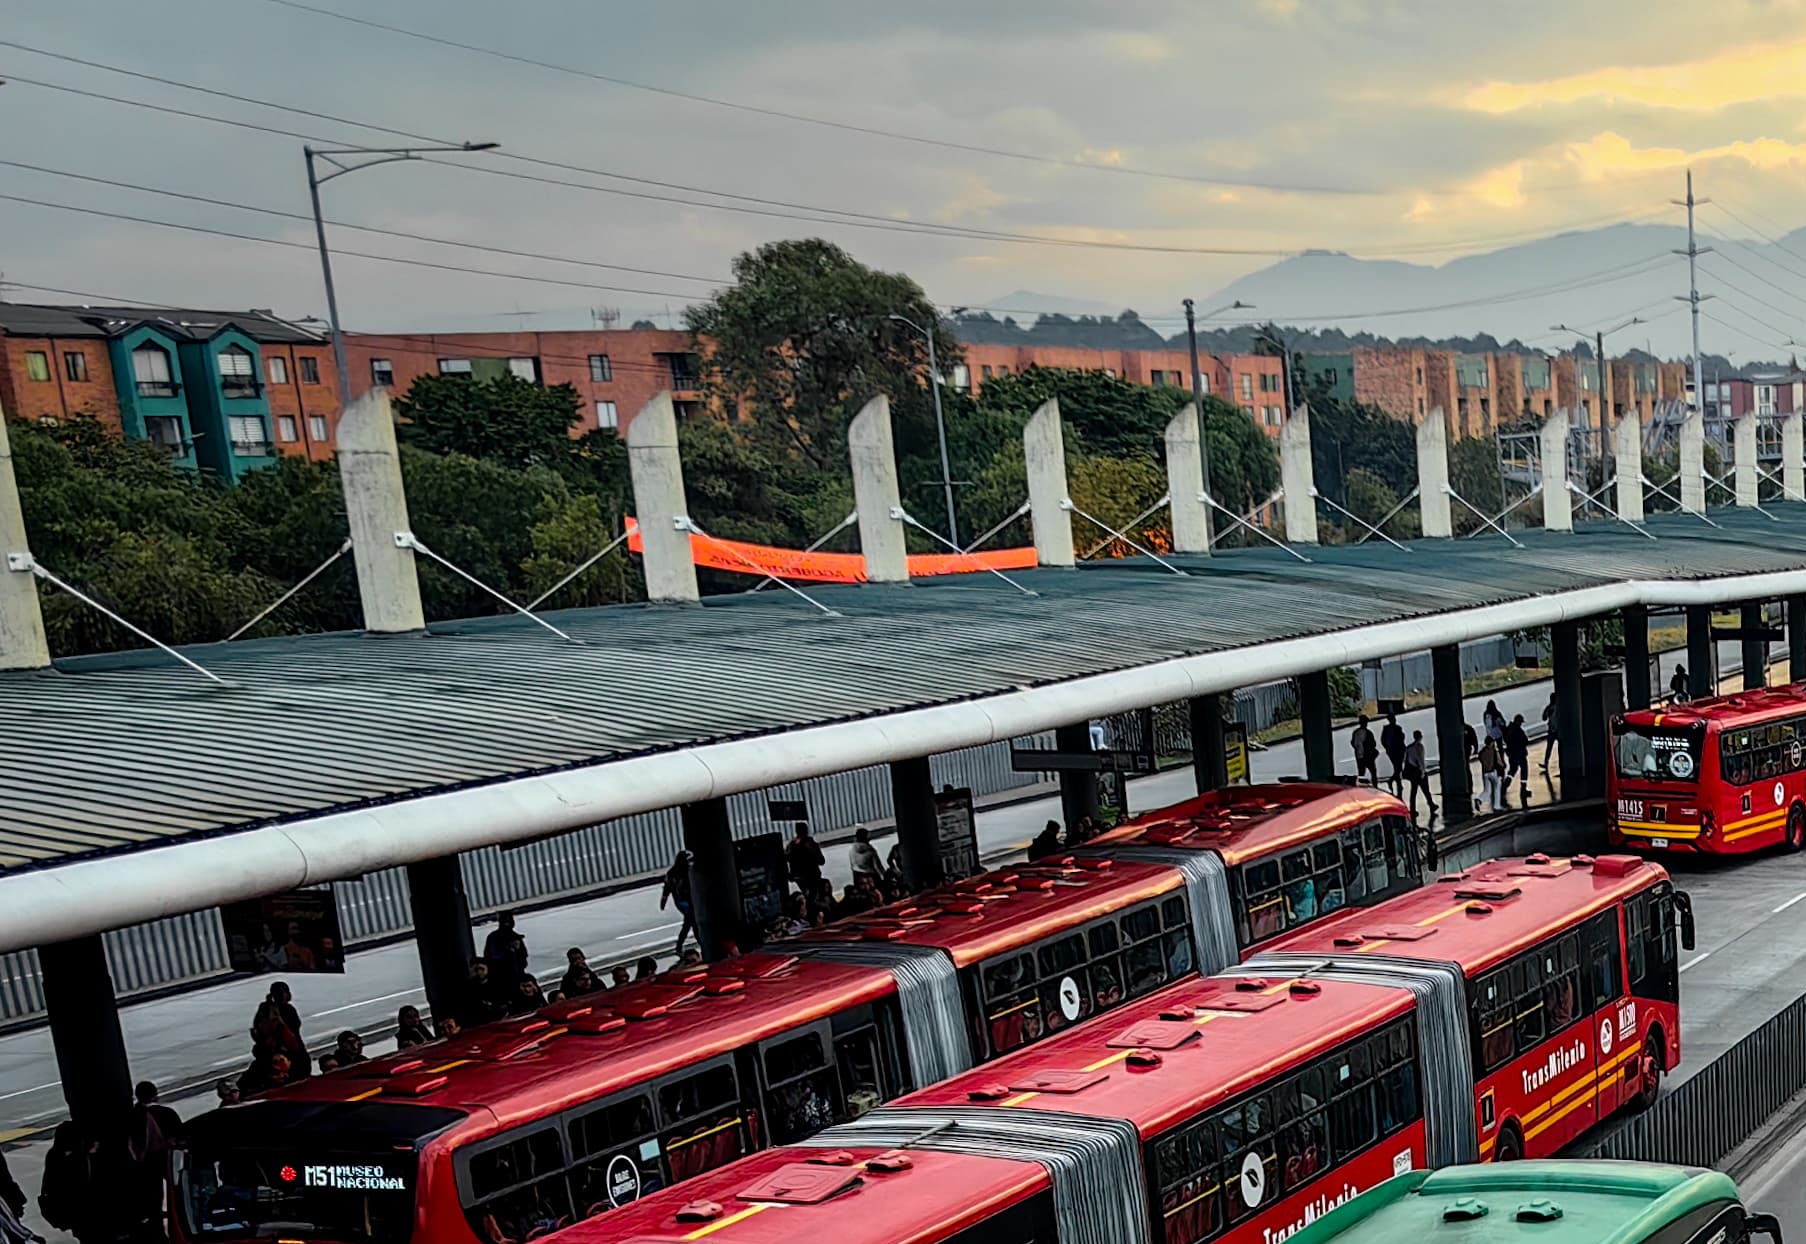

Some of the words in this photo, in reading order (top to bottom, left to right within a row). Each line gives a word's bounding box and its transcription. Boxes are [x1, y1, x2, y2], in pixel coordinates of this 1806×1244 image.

[1522, 1039, 1586, 1095] TransMilenio
[304, 1165, 335, 1187] M51
[336, 1165, 384, 1177] MUSEO
[336, 1177, 405, 1190] NACIONAL
